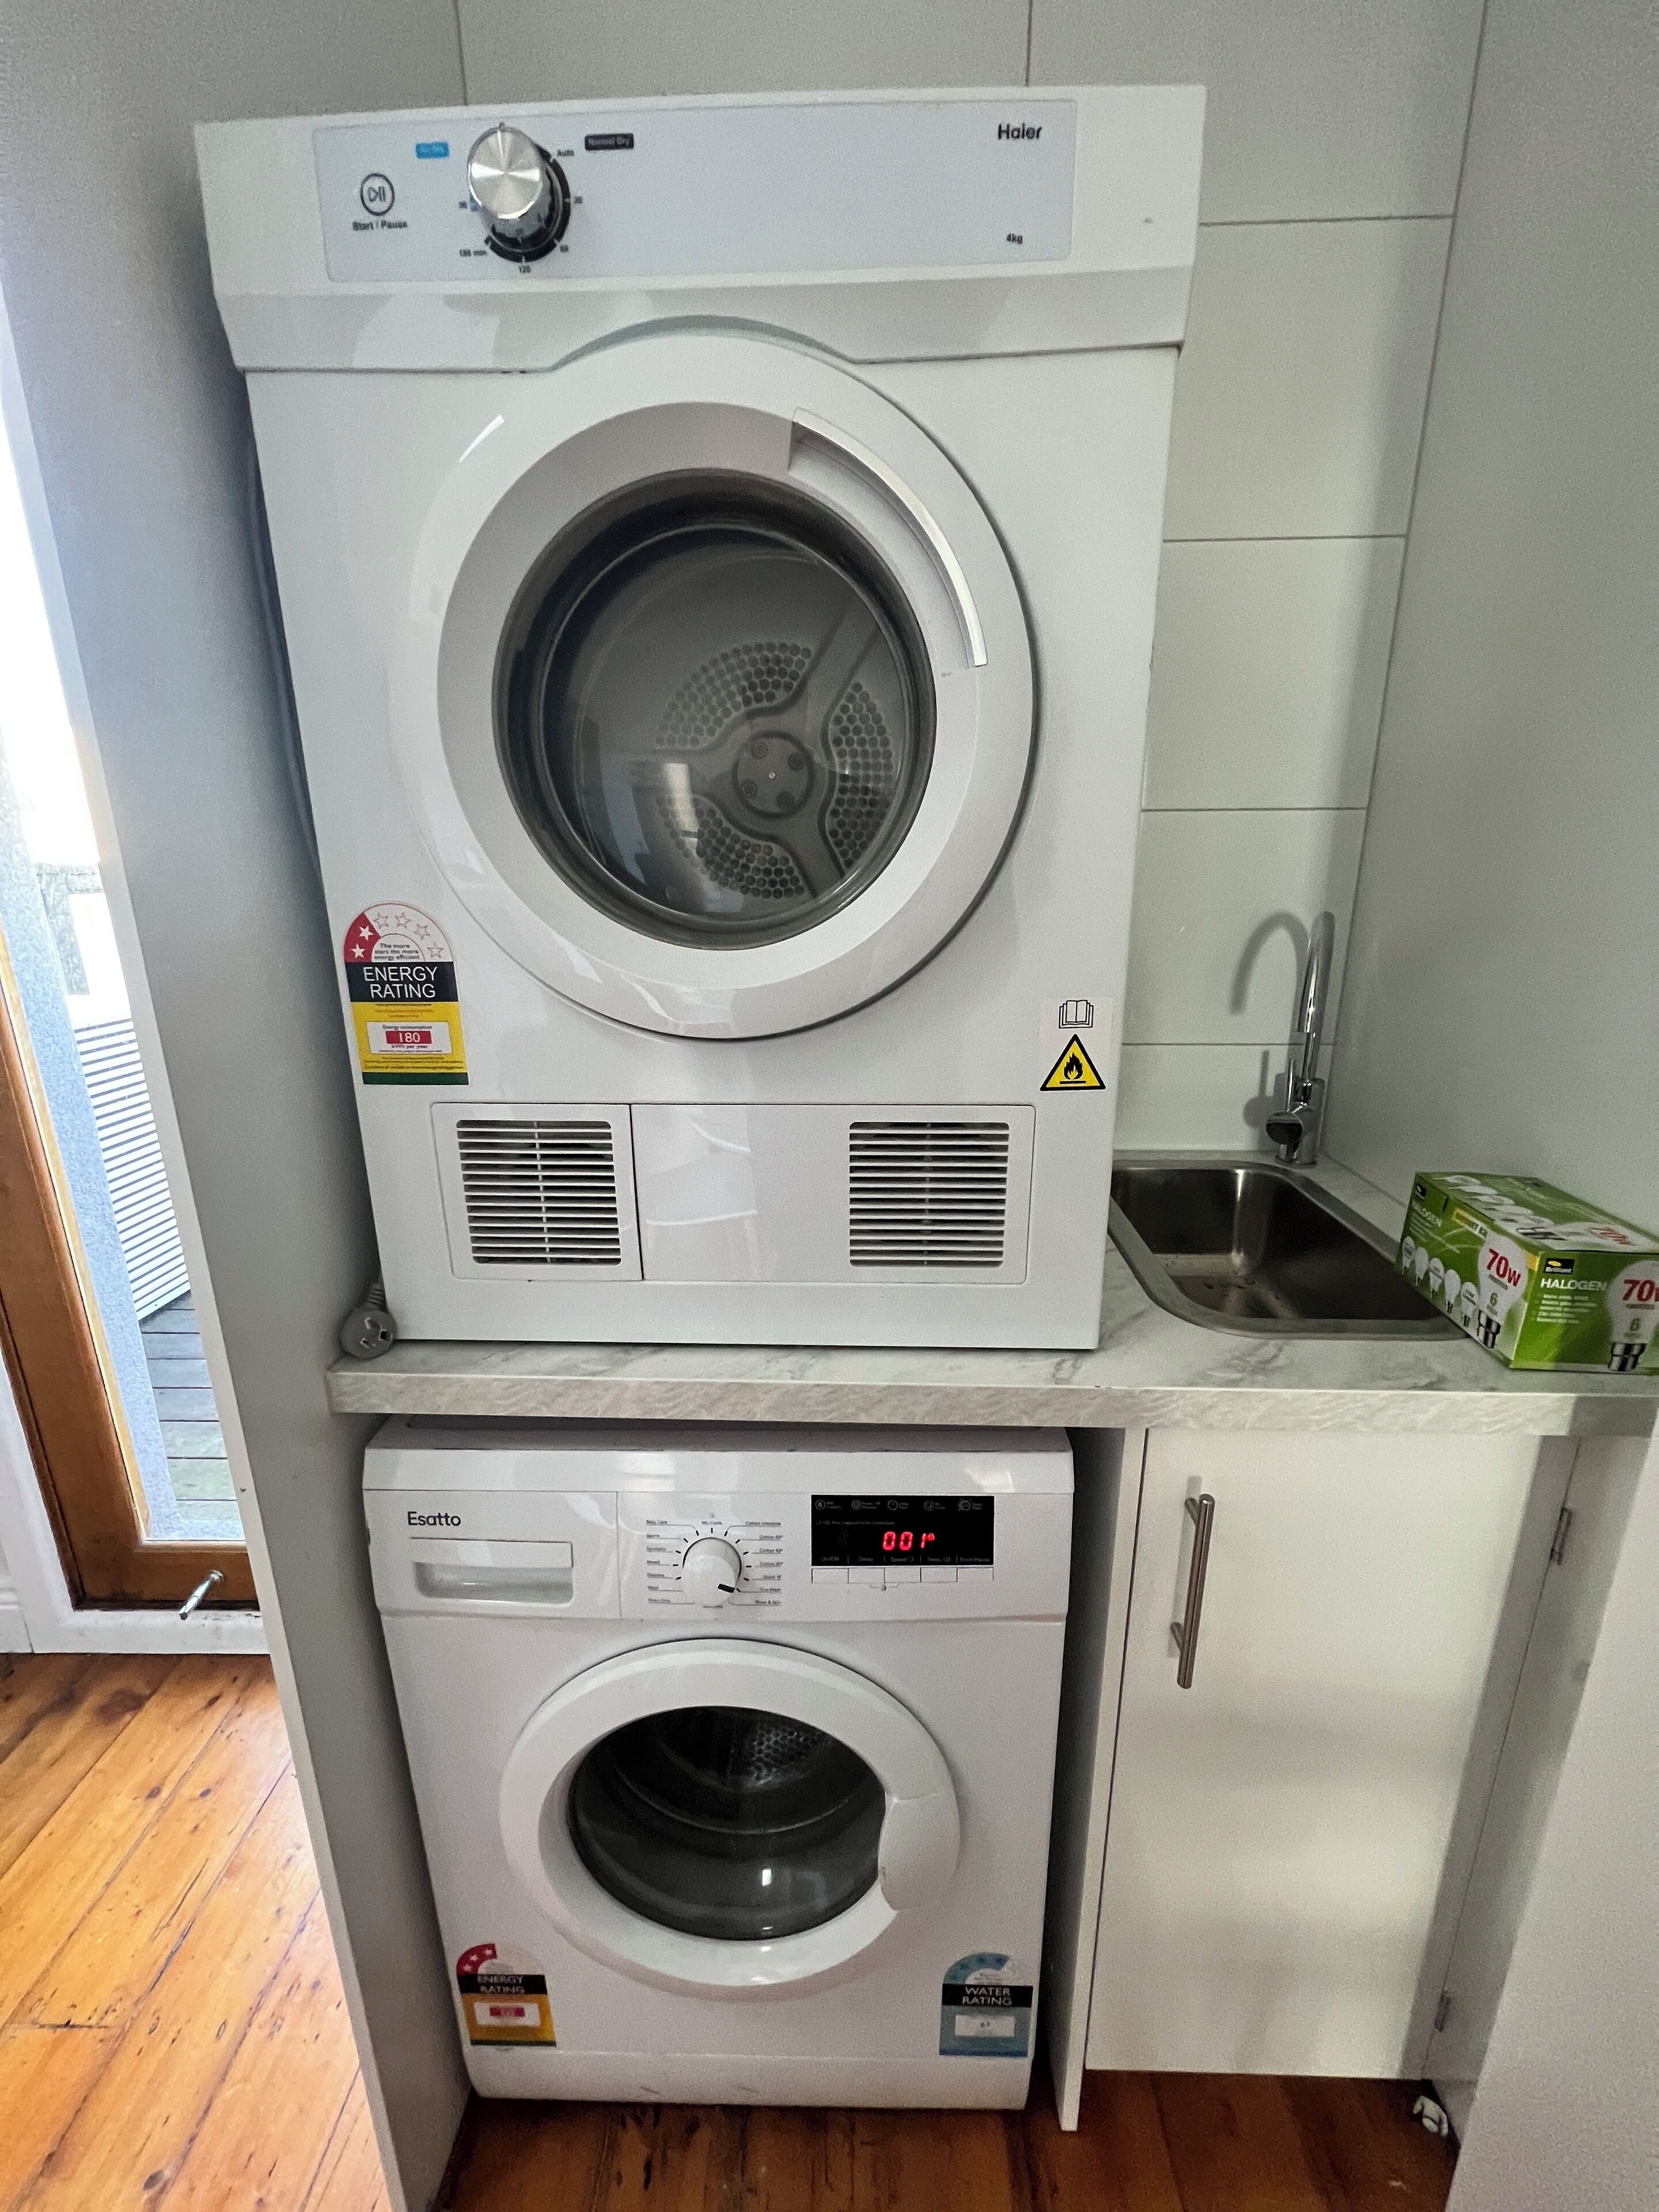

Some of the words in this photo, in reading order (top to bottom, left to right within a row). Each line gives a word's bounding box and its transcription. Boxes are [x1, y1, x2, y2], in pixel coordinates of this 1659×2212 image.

[997, 122, 1042, 140] Haier
[588, 137, 615, 146] Normal
[616, 137, 630, 146] Dry
[381, 219, 408, 229] Pause
[519, 266, 531, 274] 120
[363, 966, 438, 982] ENERGY
[370, 983, 436, 999] RATING
[399, 1032, 420, 1043] 180
[1540, 1278, 1608, 1291] HALOGEN
[1490, 1292, 1499, 1306] 6
[407, 1510, 461, 1527] Esatto
[478, 1976, 524, 1984] ENERGY
[480, 1986, 525, 1994] RATING
[964, 1986, 1010, 1996] WATER
[963, 1996, 1012, 2006] RATING
